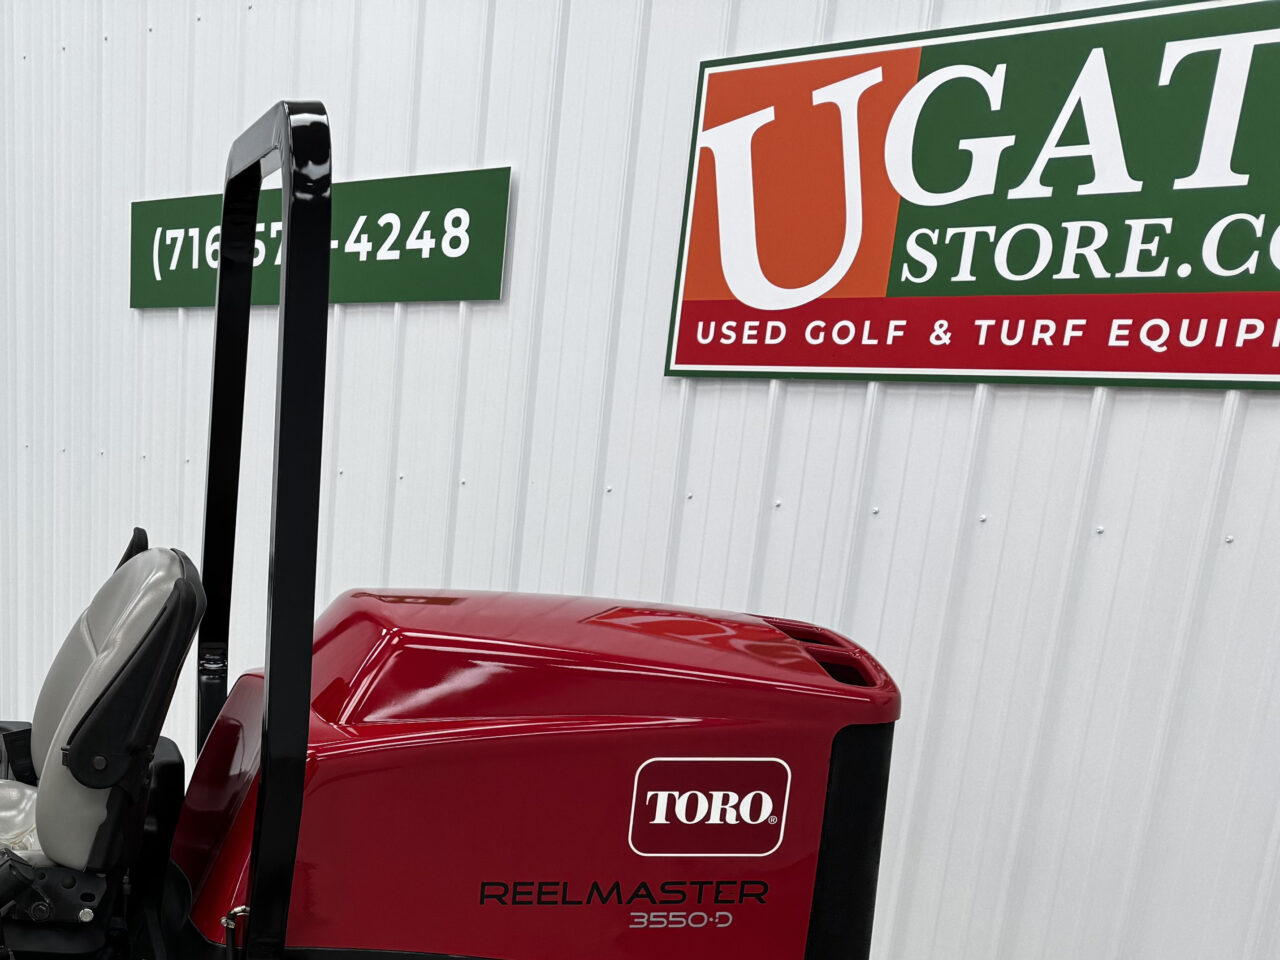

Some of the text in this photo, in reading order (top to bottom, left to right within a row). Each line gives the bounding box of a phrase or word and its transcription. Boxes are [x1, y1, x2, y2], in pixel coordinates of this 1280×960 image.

[696, 317, 1280, 353] USED GOLF & TURF EQUIP
[479, 880, 769, 906] REELMASTER
